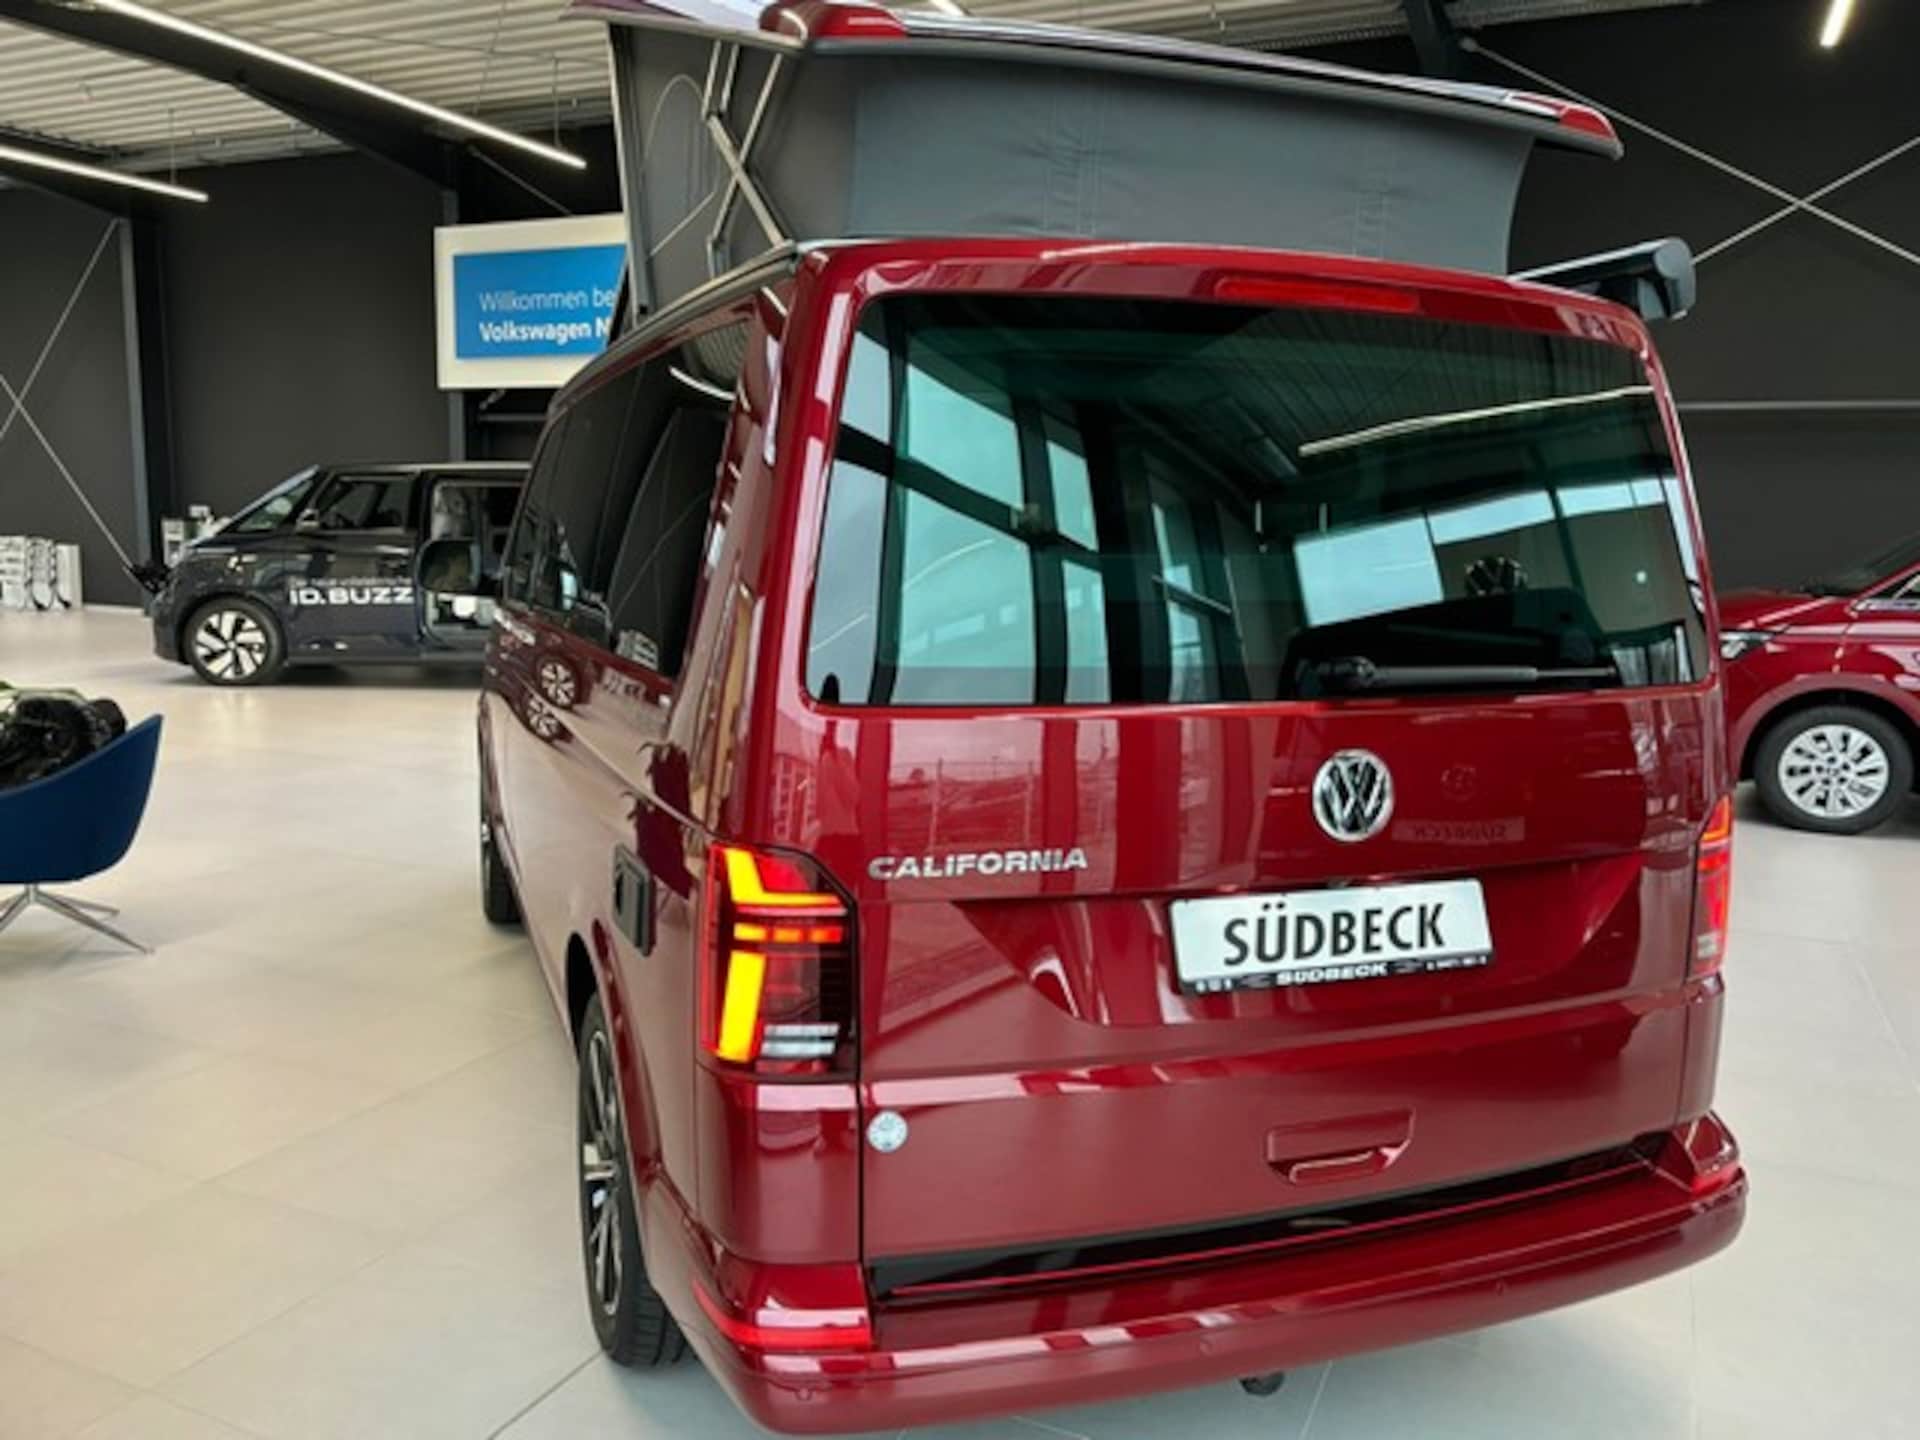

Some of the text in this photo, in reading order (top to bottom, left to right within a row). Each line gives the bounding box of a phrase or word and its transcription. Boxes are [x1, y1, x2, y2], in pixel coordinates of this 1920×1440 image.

[479, 286, 616, 312] Willkommen be
[479, 321, 591, 346] Volkswagen
[868, 847, 1088, 880] CALIFORNIA
[1223, 902, 1445, 966] SÜDBECK
